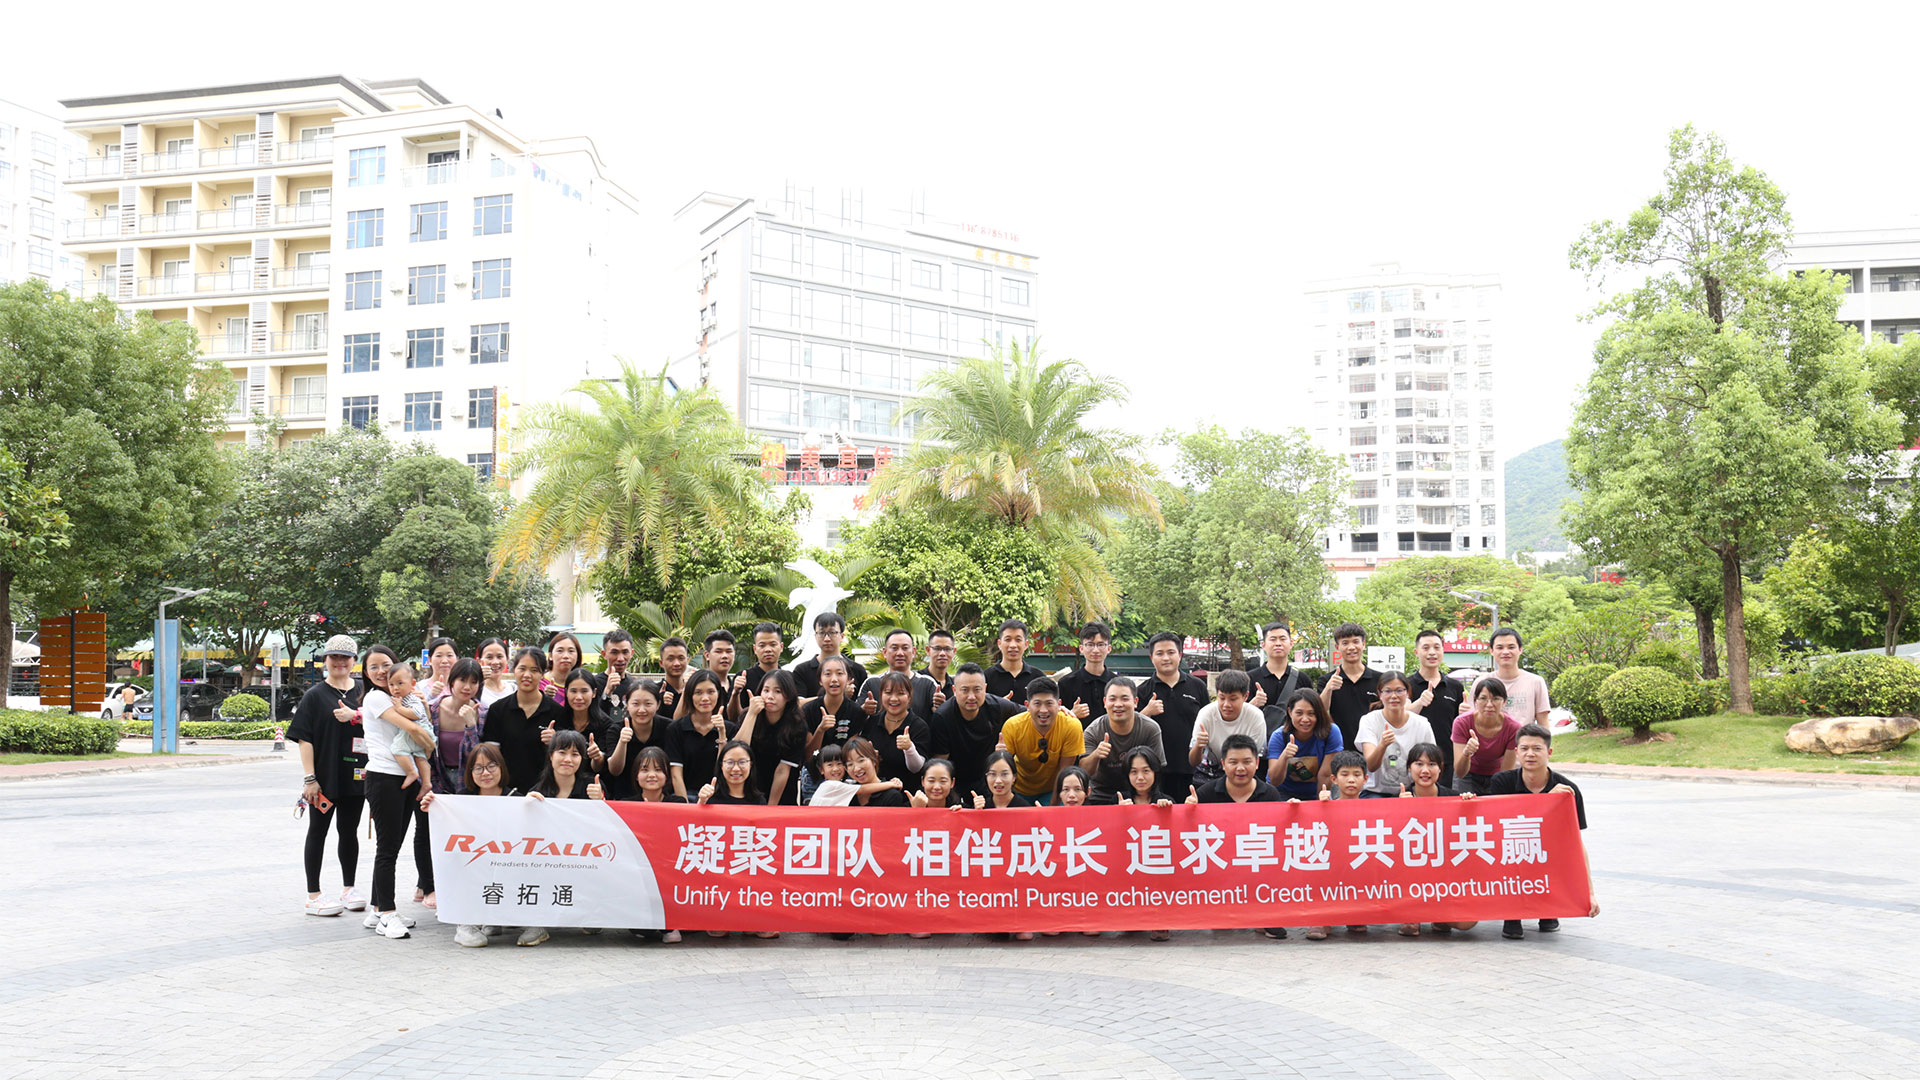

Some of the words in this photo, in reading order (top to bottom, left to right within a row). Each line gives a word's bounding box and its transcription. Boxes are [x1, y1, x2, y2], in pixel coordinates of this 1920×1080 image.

[800, 444, 894, 469] 美宜佳
[1388, 654, 1396, 663] P
[675, 823, 885, 878] 凝聚团队
[901, 826, 1109, 878] 相伴成长
[1125, 821, 1331, 875] 追求卓越
[1348, 814, 1548, 870] 共创共赢
[544, 862, 599, 870] Professionals
[482, 881, 574, 907] 睿拓通
[673, 884, 731, 911] Unify
[737, 886, 774, 907] the
[780, 887, 843, 908] team!
[850, 887, 908, 908] Grow
[914, 887, 950, 908] the
[957, 888, 1019, 908] team!
[1026, 887, 1099, 908] Pursue
[1105, 884, 1248, 907] achievement!
[1255, 883, 1314, 904] Creat
[1319, 879, 1403, 902] win-win
[1408, 874, 1550, 903] opportunities!
